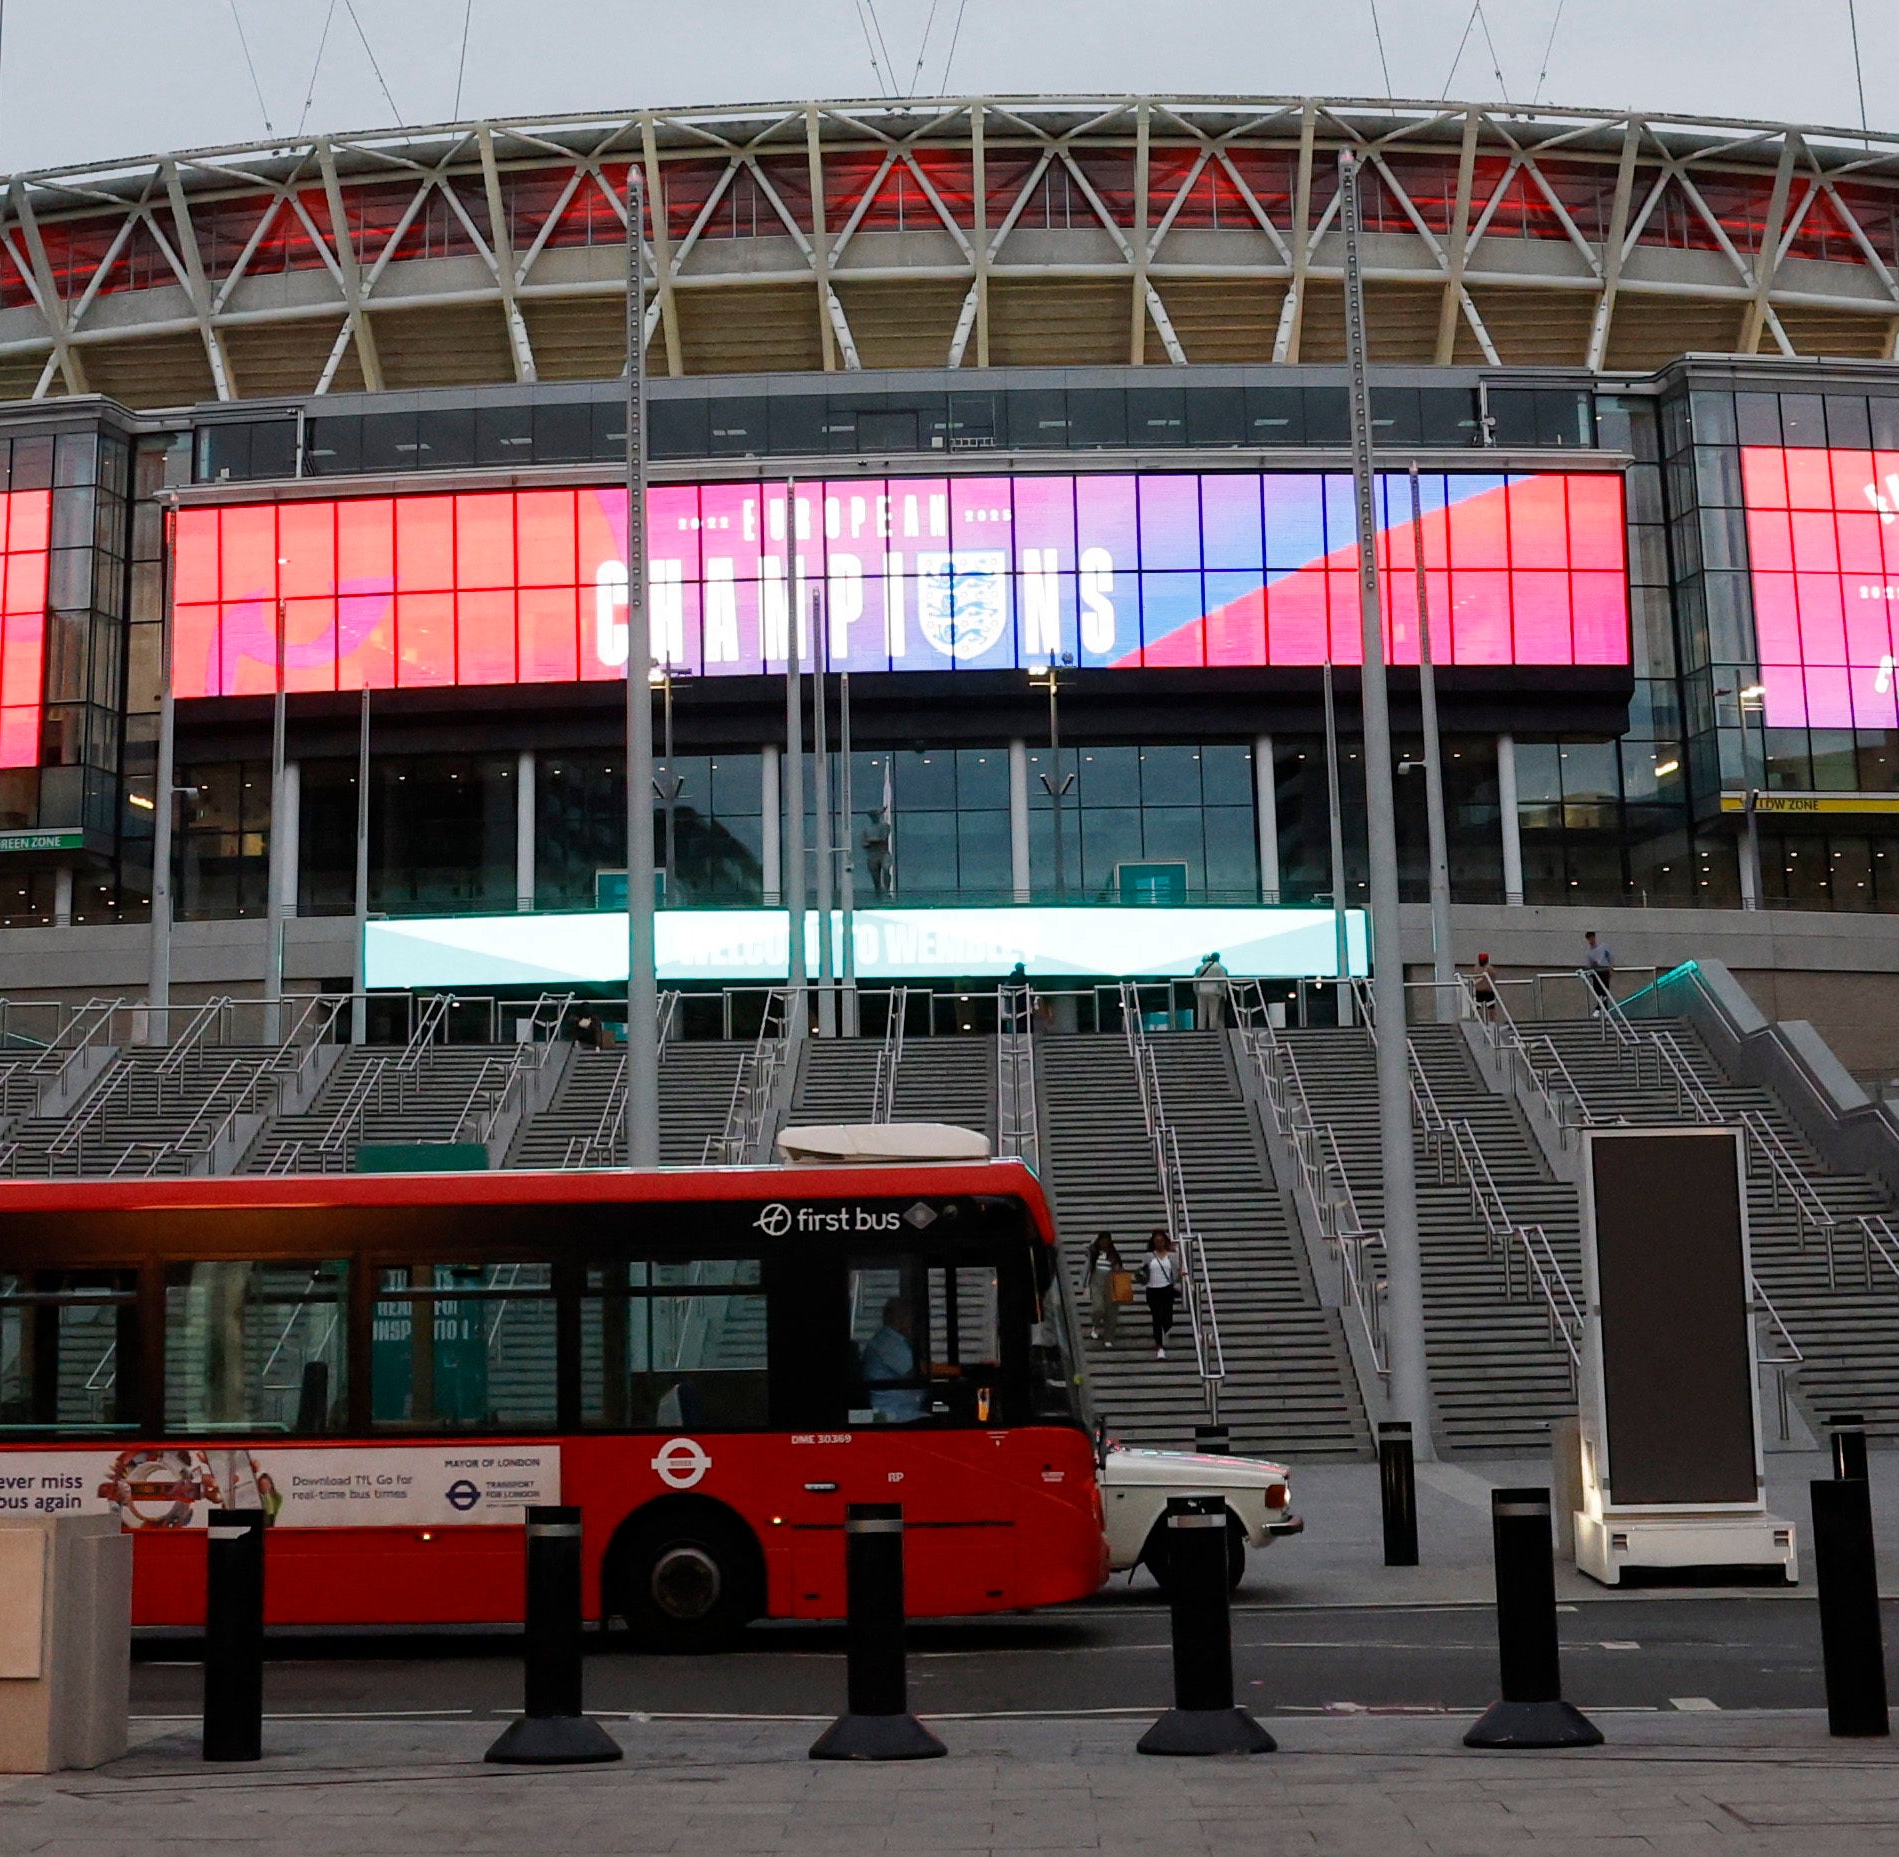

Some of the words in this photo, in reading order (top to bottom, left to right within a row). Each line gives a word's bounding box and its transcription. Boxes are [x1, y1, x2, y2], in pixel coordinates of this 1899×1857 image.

[678, 517, 729, 531] 2022
[743, 494, 947, 542] EUROPEAN
[964, 508, 1013, 523] 2025
[1789, 799, 1819, 811] ZONE
[31, 836, 62, 848] ZONE
[797, 1206, 850, 1232] first
[855, 1206, 901, 1231] bus
[444, 1458, 479, 1469] MAYOR
[482, 1458, 495, 1468] OF
[496, 1458, 540, 1468] LONDON
[41, 1472, 83, 1489] miss
[292, 1475, 352, 1488] Download
[355, 1475, 372, 1487] TfL
[375, 1475, 393, 1486] Go
[395, 1474, 413, 1486] for
[292, 1489, 346, 1501] real-time
[349, 1488, 370, 1500] bus
[373, 1488, 407, 1500] times
[34, 1492, 82, 1513] again
